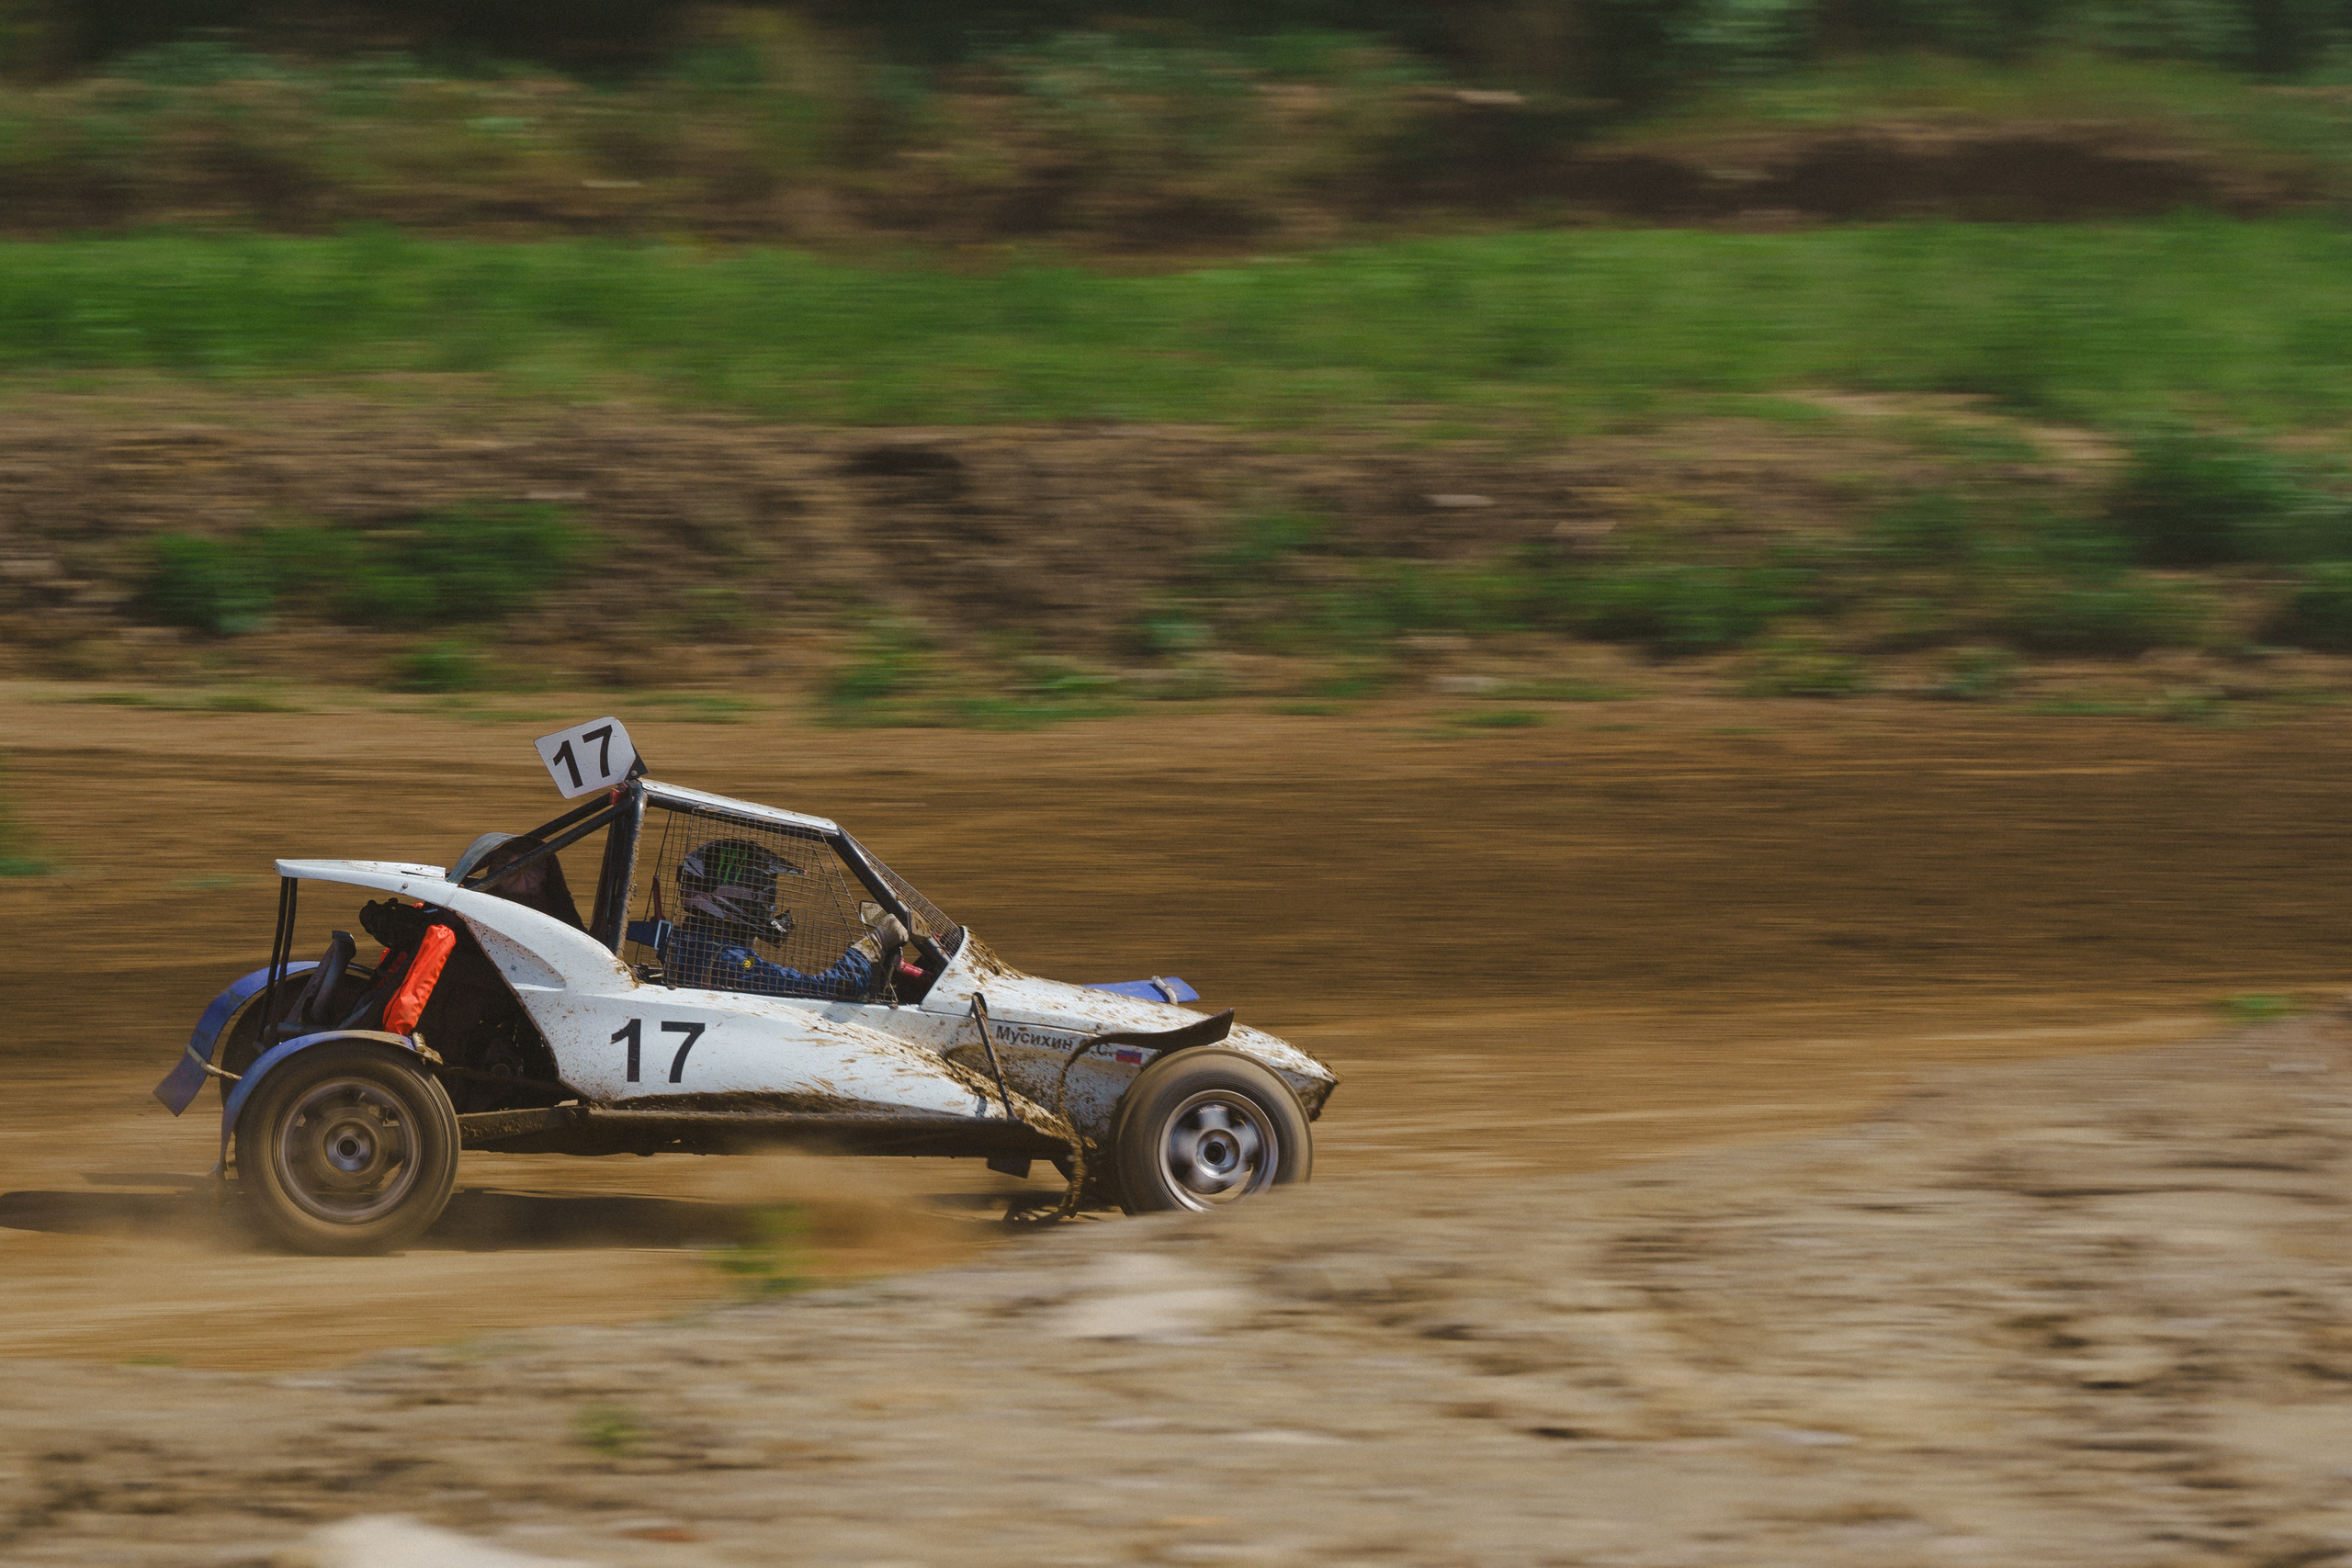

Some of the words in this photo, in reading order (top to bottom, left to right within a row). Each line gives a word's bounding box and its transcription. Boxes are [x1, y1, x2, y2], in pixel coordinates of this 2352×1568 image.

[552, 724, 614, 789] 17
[610, 1018, 707, 1084] 17
[996, 1025, 1072, 1049] Мусихин
